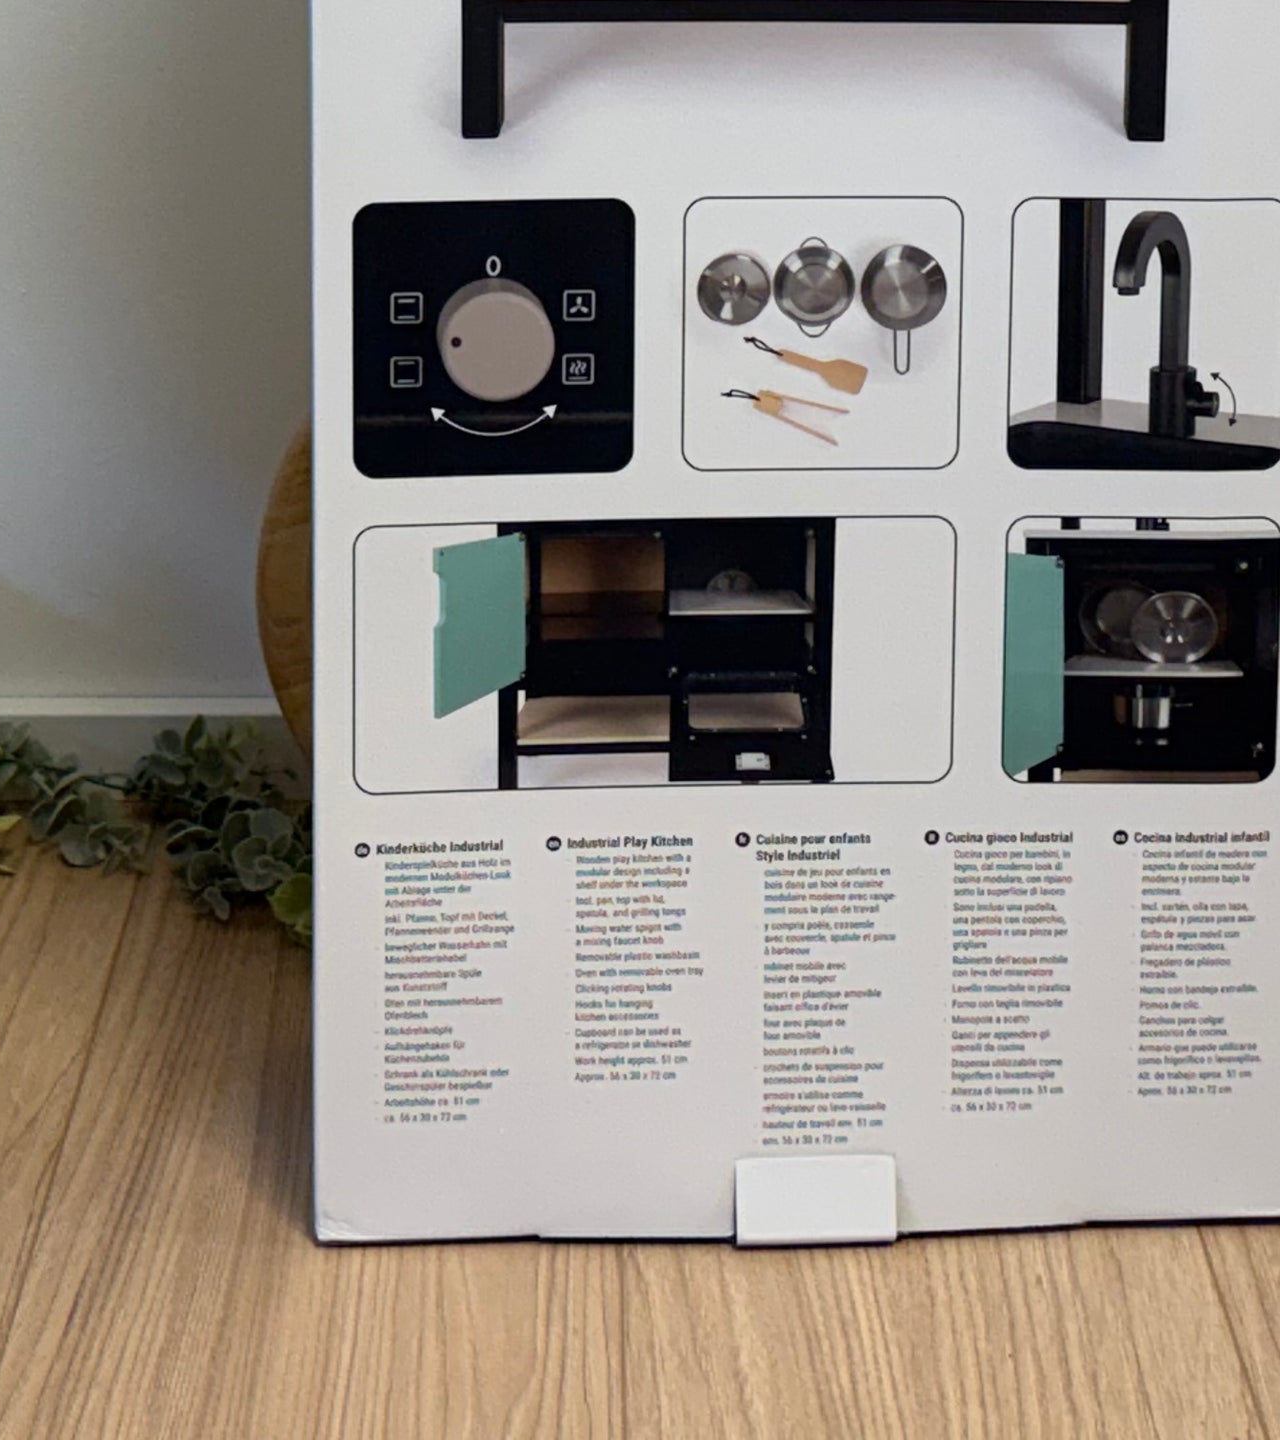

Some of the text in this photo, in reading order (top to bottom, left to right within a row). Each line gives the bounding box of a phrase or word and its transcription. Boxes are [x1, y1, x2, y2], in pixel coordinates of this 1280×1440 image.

[486, 255, 501, 277] 0
[567, 838, 620, 849] Industrial
[624, 836, 647, 849] Play
[651, 836, 693, 846] Kitchen
[756, 834, 797, 845] Cuisine
[801, 836, 825, 845] pour
[829, 834, 870, 844] enfants
[945, 832, 983, 843] Cucina
[986, 834, 1017, 845] gioco
[1020, 832, 1073, 843] Industrial
[1134, 832, 1172, 843] Cocina
[1175, 832, 1228, 843] industrial
[1231, 831, 1270, 842] infantil
[376, 843, 446, 854] Kinderküche
[450, 841, 503, 852] Industrial
[756, 850, 840, 862] Style Industriel
